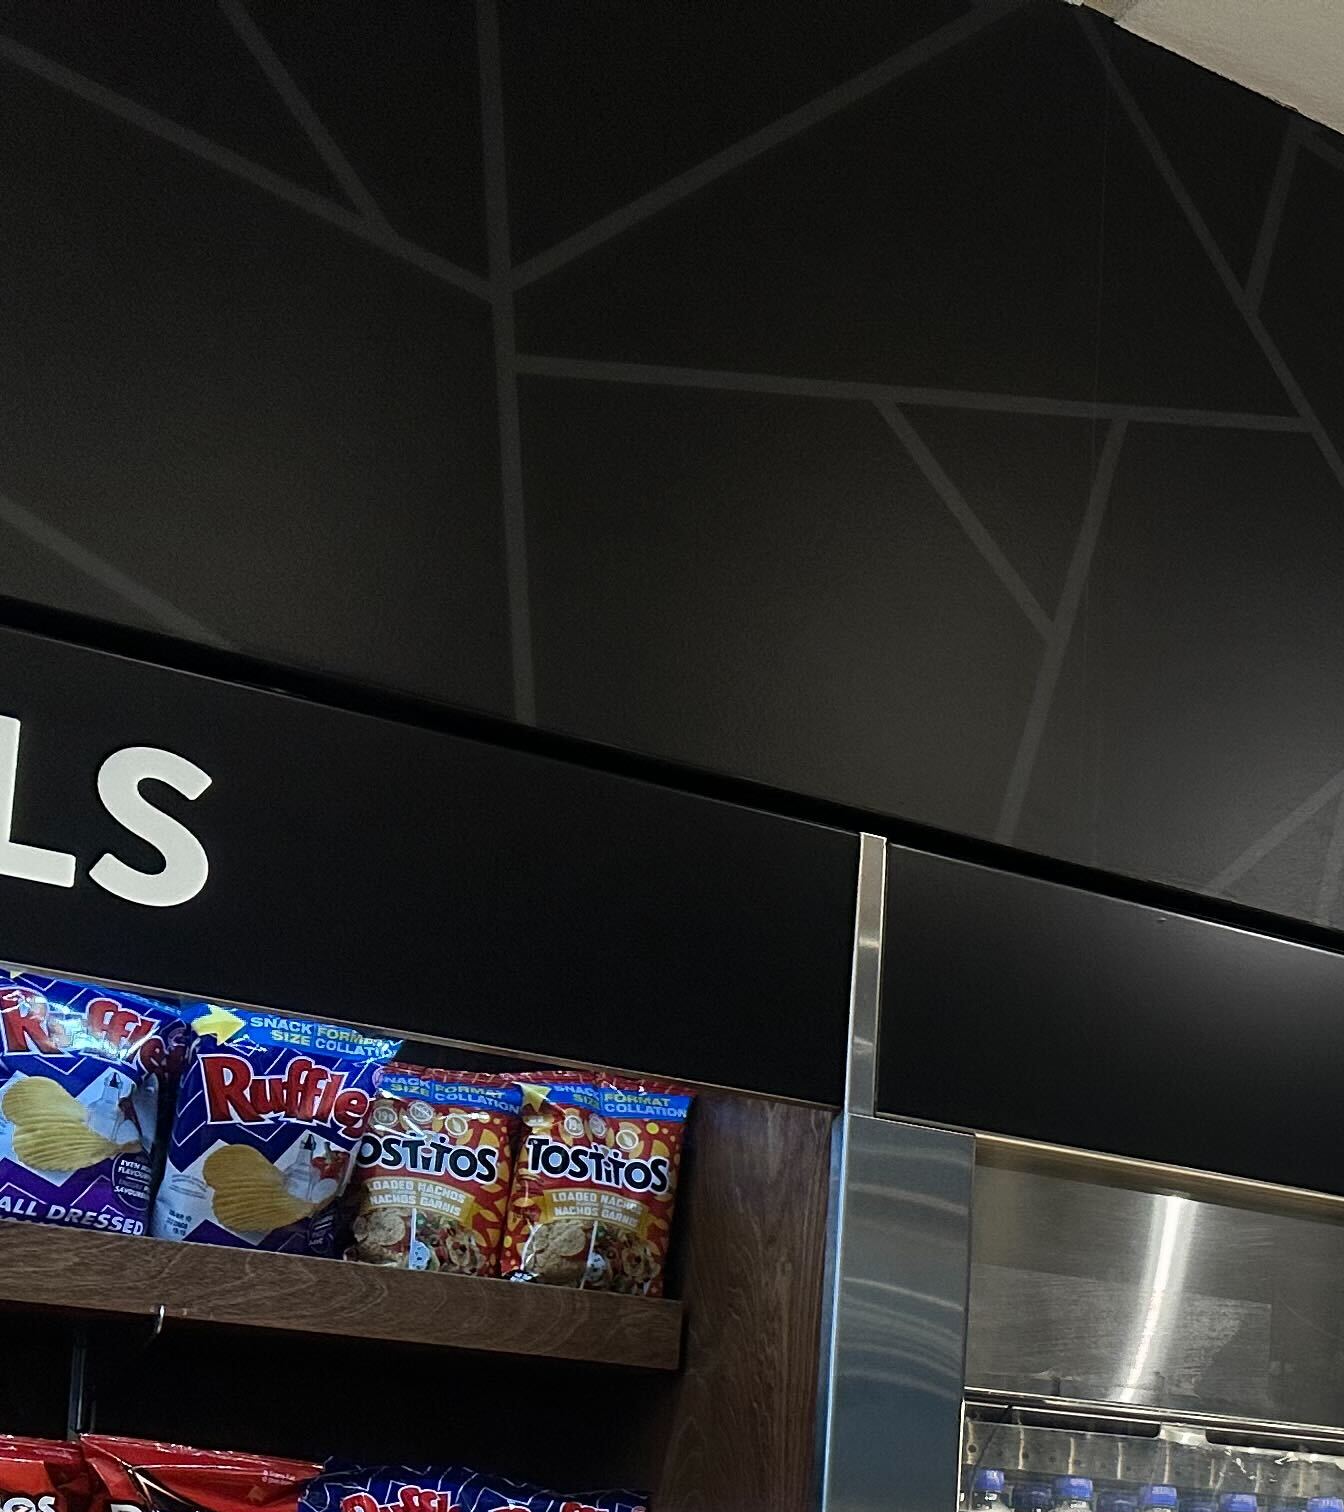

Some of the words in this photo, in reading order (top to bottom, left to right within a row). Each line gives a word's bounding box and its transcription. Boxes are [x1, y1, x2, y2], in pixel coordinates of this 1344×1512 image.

[250, 1016, 312, 1034] SNACK
[271, 1029, 311, 1048] SIZE
[434, 1093, 521, 1114] COLLATION
[604, 1093, 671, 1107] FORMAT
[604, 1102, 688, 1119] COLLATION
[45, 1203, 145, 1237] DRESSED
